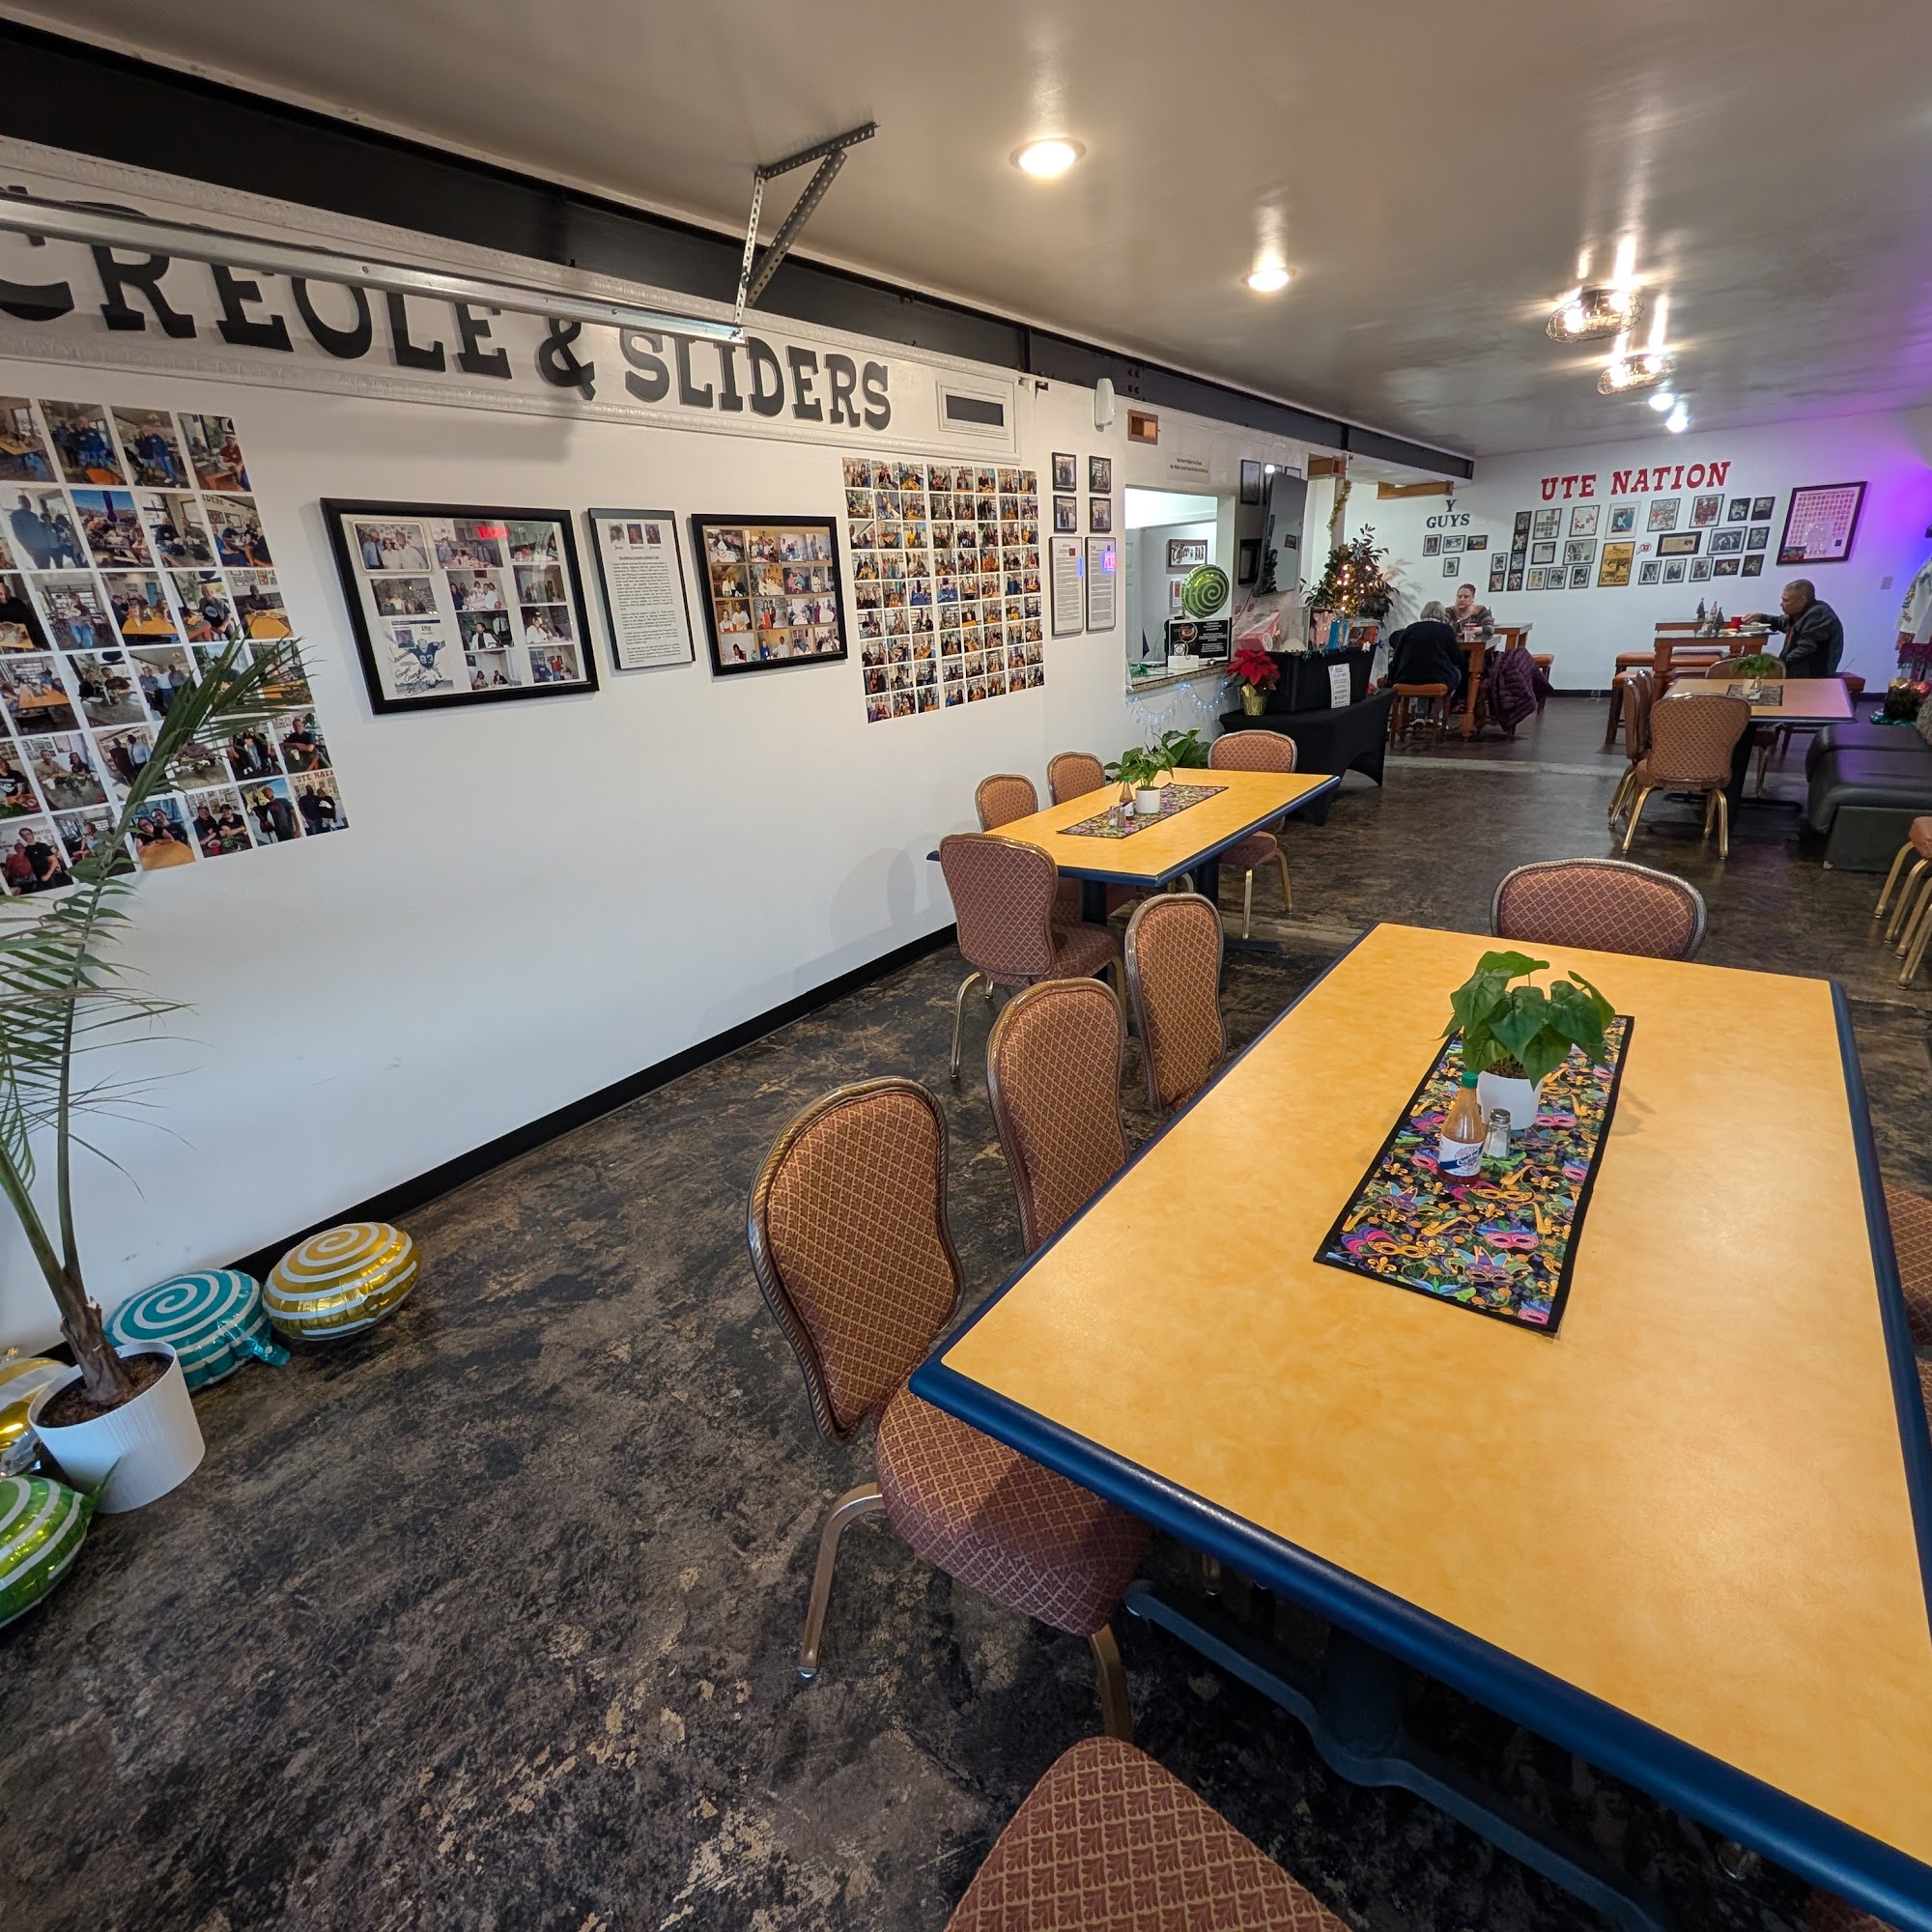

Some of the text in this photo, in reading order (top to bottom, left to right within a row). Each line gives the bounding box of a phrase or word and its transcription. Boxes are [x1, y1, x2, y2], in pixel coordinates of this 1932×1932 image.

[536, 316, 596, 402] &
[619, 327, 892, 430] SLIDERS
[1541, 461, 1731, 501] UTE NATION
[1445, 498, 1458, 513] Y
[1426, 513, 1470, 528] GUYS
[1194, 546, 1205, 561] BAR
